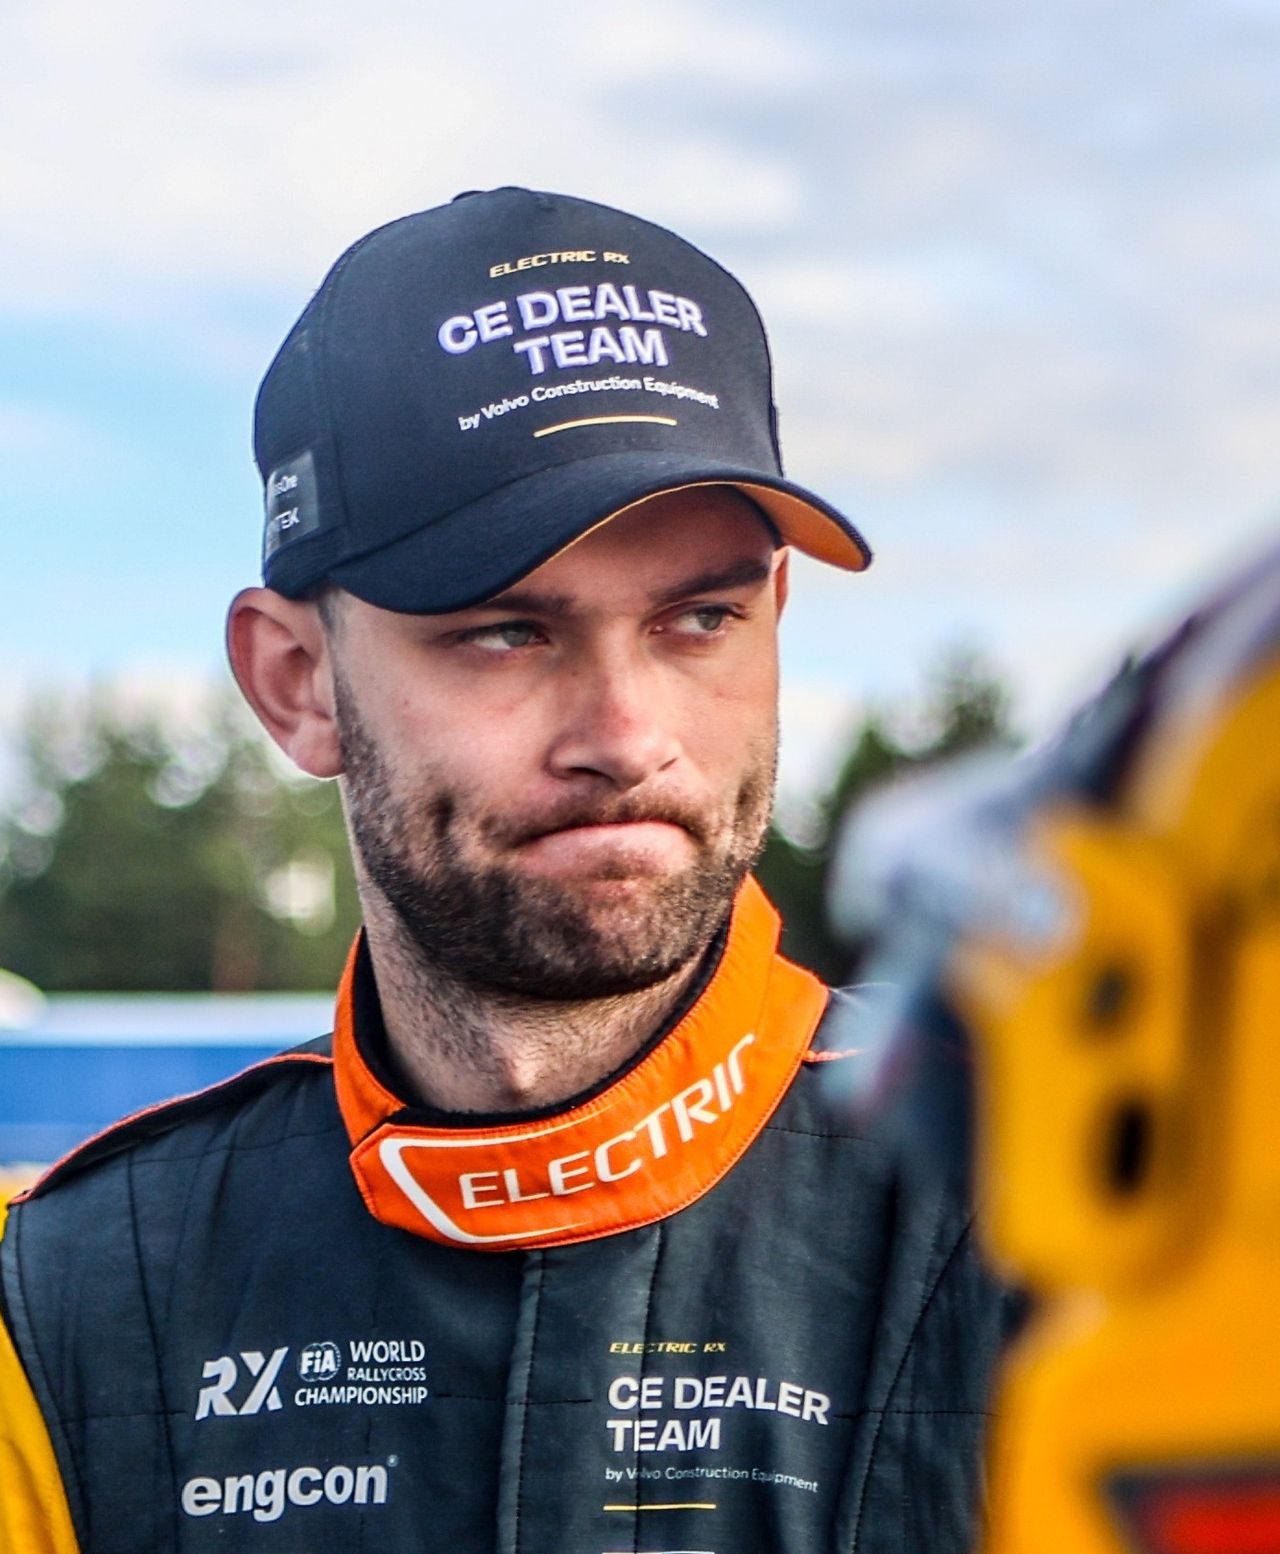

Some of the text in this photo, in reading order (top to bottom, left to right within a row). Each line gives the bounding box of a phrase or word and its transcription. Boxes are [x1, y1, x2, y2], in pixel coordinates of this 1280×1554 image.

[489, 250, 630, 278] ELECTRIC RX
[437, 282, 708, 355] CE DEALER
[513, 326, 670, 375] TEAM
[458, 375, 720, 431] by Volvo Construction Equipment
[349, 1340, 426, 1363] WORLD
[609, 1342, 727, 1354] ELECTRIC RX
[194, 1346, 289, 1421] RX
[347, 1367, 427, 1382] RALLYCROSS
[294, 1386, 429, 1406] CHAMPIONSHIP
[607, 1375, 832, 1426] CE DEALER
[605, 1417, 721, 1452] TEAM
[605, 1465, 819, 1494] by Vlvo Construction Equipment
